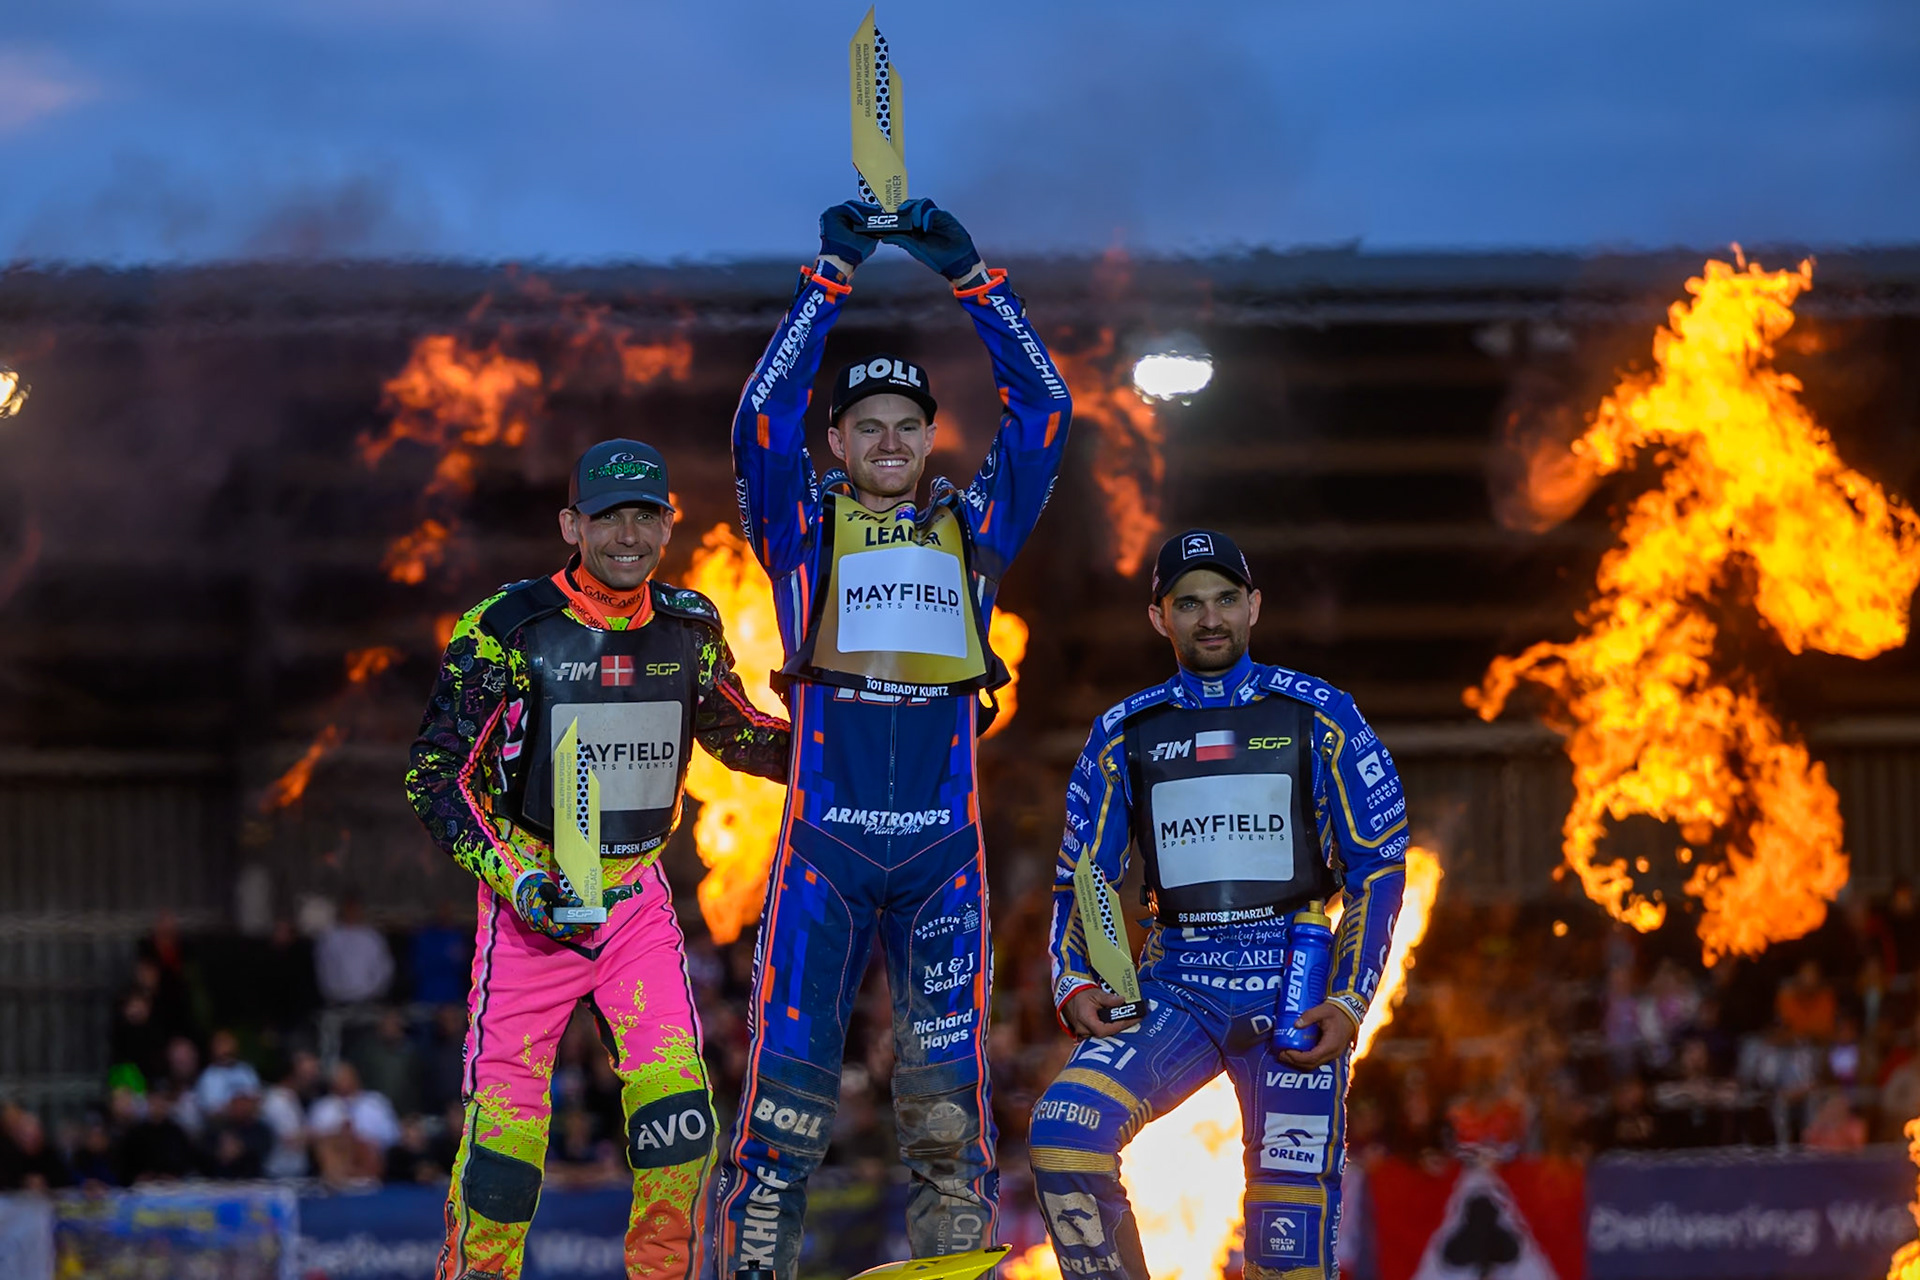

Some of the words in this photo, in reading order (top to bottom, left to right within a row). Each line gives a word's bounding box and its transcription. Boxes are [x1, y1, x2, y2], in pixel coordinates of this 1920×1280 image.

[892, 175, 902, 209] WINNER
[867, 214, 898, 225] SGP
[751, 290, 825, 412] ARMSTRONG'S
[849, 358, 921, 388] BOLL
[865, 525, 942, 546] LEAR
[1187, 546, 1209, 555] ORLEN
[847, 583, 959, 607] MAYFIELD
[846, 603, 902, 613] SPORTS
[915, 604, 960, 616] EVENTS
[552, 662, 598, 681] FIM
[645, 663, 681, 676] SGP
[866, 679, 882, 691] 101
[884, 683, 918, 696] BRADY
[919, 686, 949, 697] KURTZ
[1131, 688, 1165, 705] ORLEN
[1270, 672, 1331, 702] MCG
[584, 742, 675, 762] AYFIELD
[1148, 739, 1192, 762] FIM
[1248, 737, 1292, 750] SGP
[628, 762, 674, 770] EVENTS
[1066, 791, 1076, 802] OIL
[1069, 782, 1090, 804] ORLEN
[1368, 787, 1398, 810] CARGO
[822, 807, 951, 827] ARMSTRONG'S
[863, 823, 897, 835] Plant
[1161, 814, 1284, 841] MAYFIELD
[612, 843, 640, 855] JEPSEN
[640, 836, 662, 852] JENSEN
[1163, 836, 1216, 849] SPORTS
[566, 910, 594, 918] SGP
[1178, 913, 1188, 922] 95
[1189, 911, 1230, 923] BARTOSZ
[1231, 906, 1275, 922] ZMARZLIK
[915, 916, 960, 937] EASTERN
[922, 925, 955, 940] POINT
[924, 962, 943, 980] M
[948, 957, 964, 973] &
[967, 952, 974, 972] J
[1285, 950, 1308, 1012] verva
[1110, 1004, 1137, 1017] SGP
[912, 1008, 973, 1035] Richard
[920, 1028, 969, 1051] Hayes
[1266, 1070, 1333, 1090] verva
[754, 1098, 822, 1139] BOLL
[637, 1109, 707, 1150] AVO
[1269, 1147, 1315, 1164] ORLEN
[740, 1166, 790, 1271] KHOFF
[936, 1215, 949, 1256] Floorin
[1270, 1238, 1296, 1246] ORLEN
[1060, 1251, 1122, 1274] ORLEN
